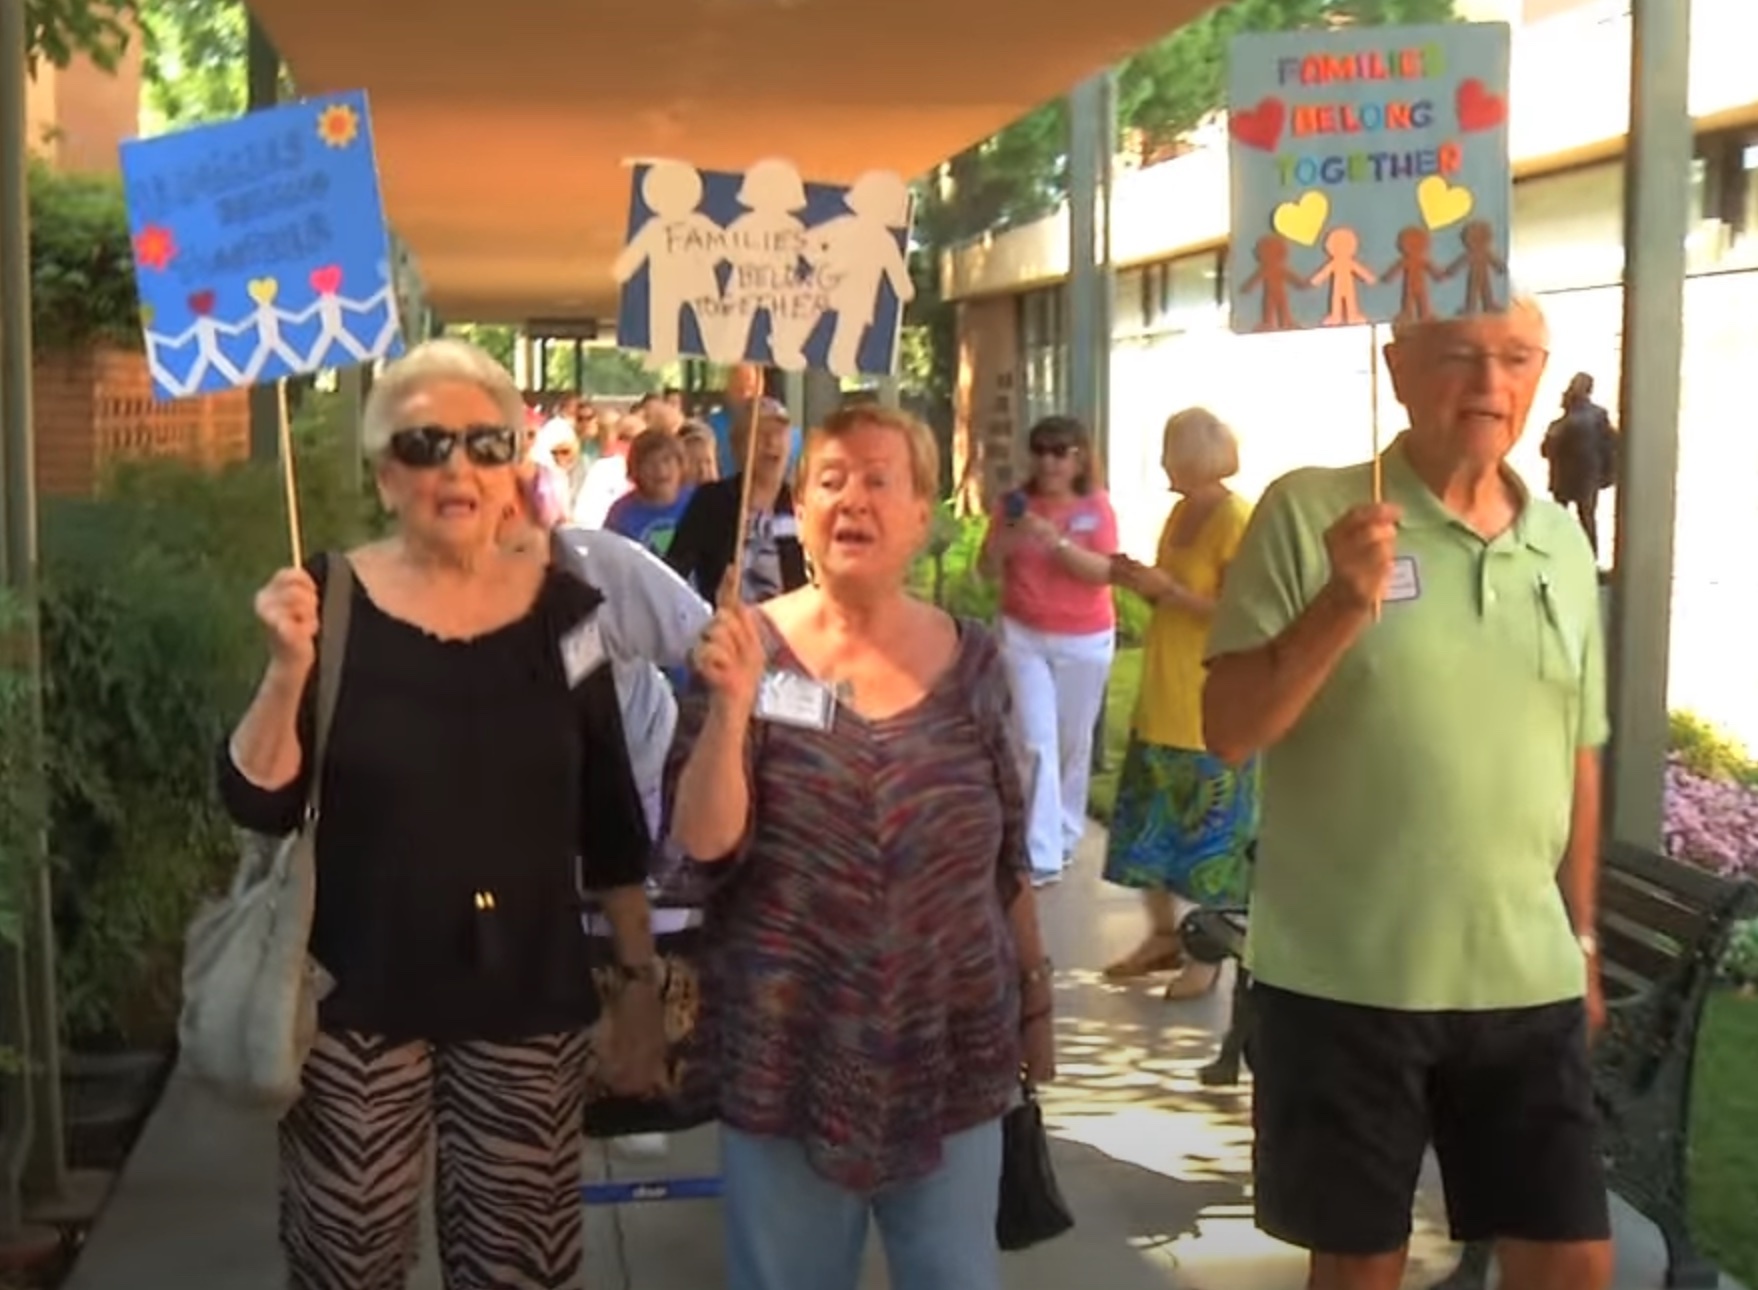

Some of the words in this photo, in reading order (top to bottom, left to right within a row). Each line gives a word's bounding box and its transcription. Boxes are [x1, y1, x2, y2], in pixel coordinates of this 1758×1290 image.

[1277, 41, 1442, 85] FAMILIES
[1293, 100, 1433, 136] BELONG
[1276, 140, 1461, 186] TOGETHER
[665, 224, 807, 254] FAMILIES
